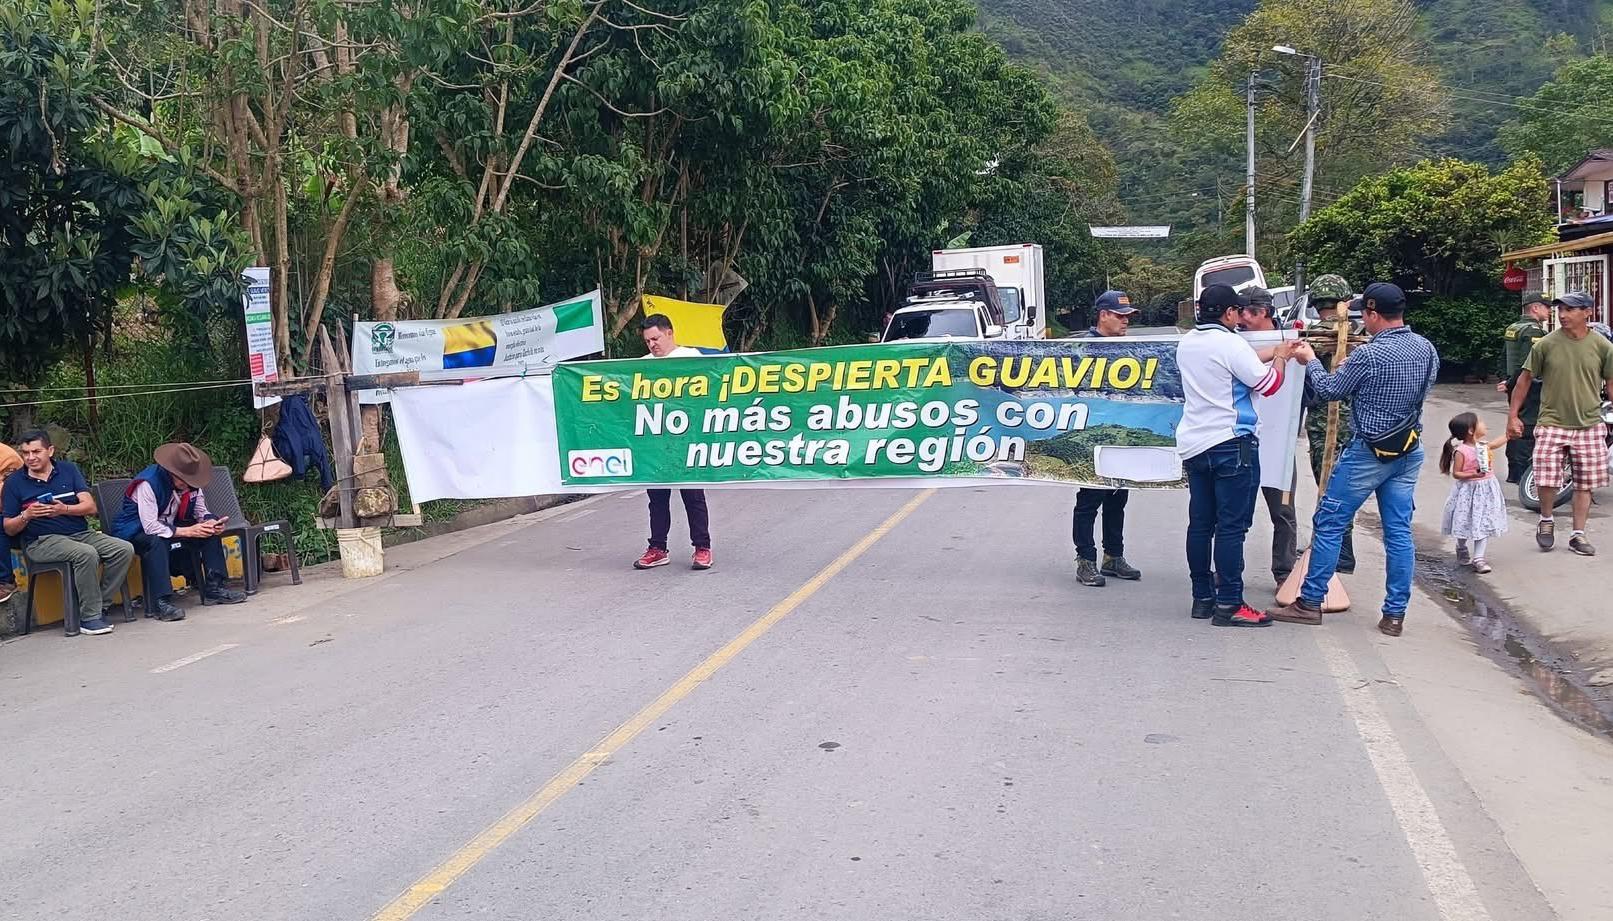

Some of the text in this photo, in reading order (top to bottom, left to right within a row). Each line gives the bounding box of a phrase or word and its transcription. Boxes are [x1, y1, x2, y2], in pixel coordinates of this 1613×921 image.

[581, 356, 1158, 402] Es hora ¡DESPIERTA GUAVIO!
[634, 396, 1089, 436] No más abusos con
[572, 450, 628, 475] enel
[686, 427, 1026, 473] nuestra región
